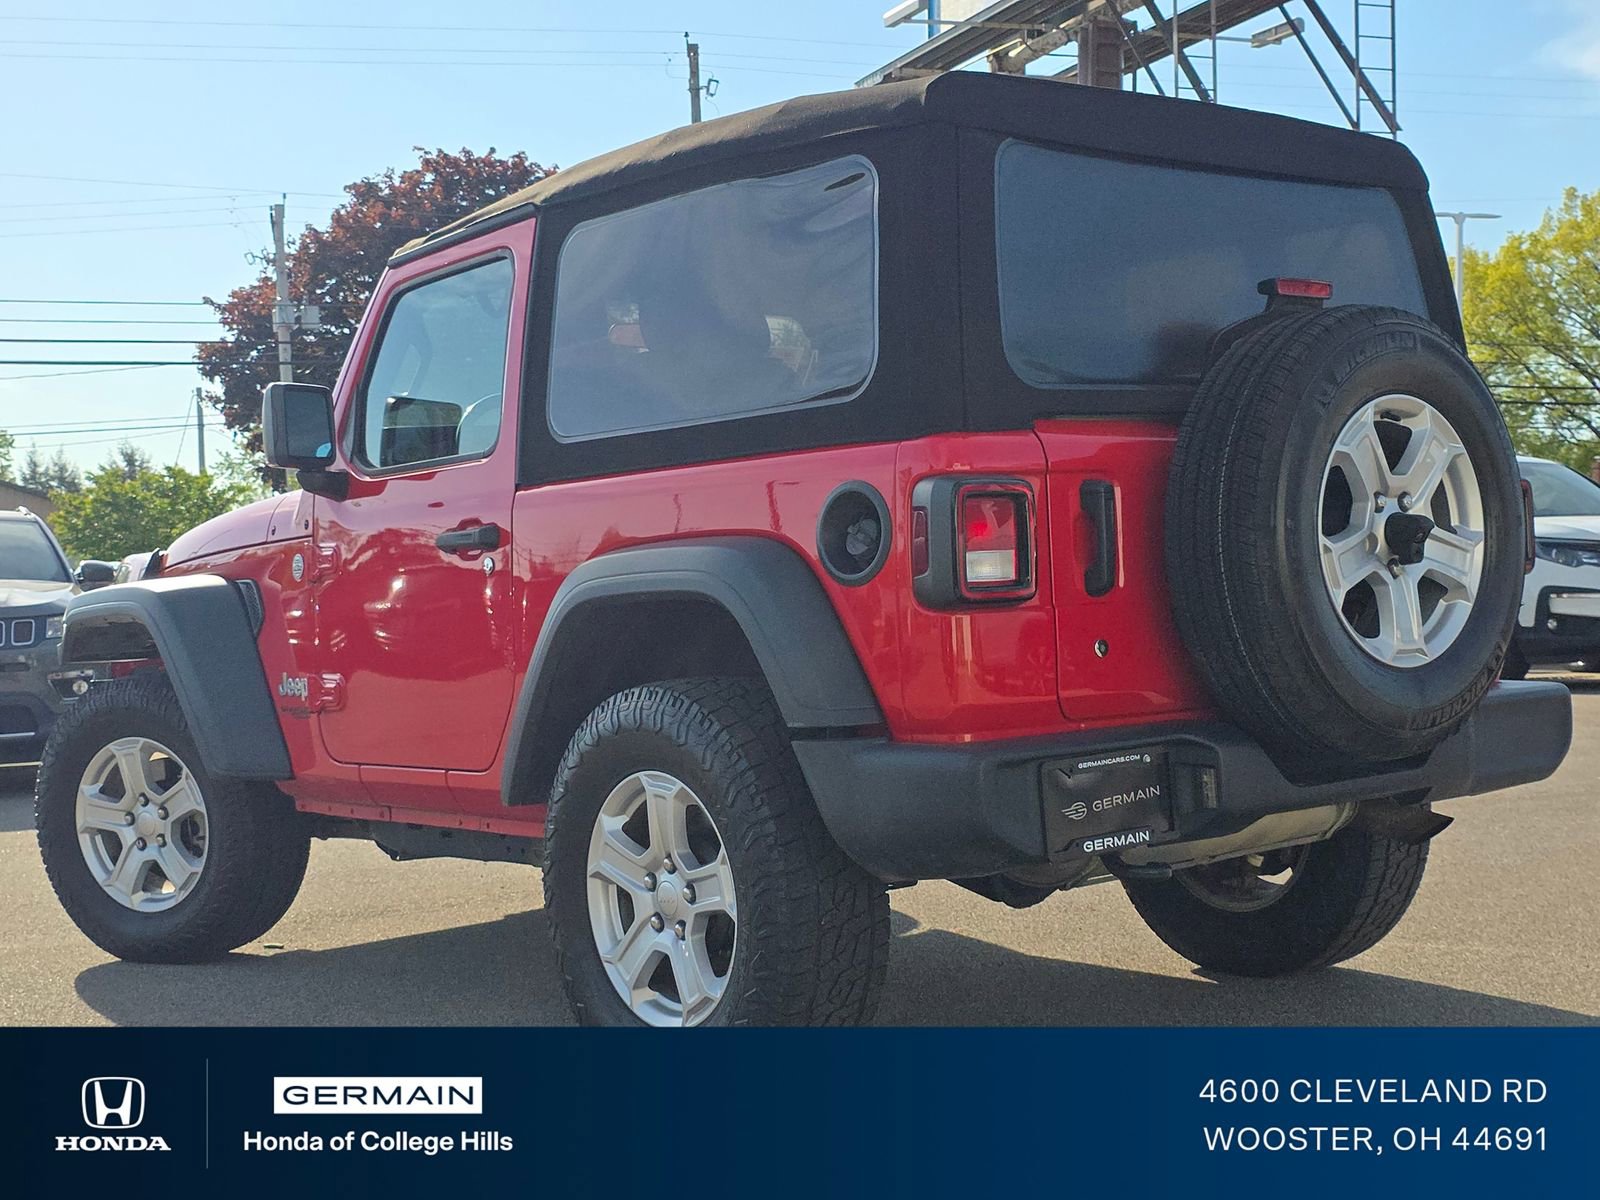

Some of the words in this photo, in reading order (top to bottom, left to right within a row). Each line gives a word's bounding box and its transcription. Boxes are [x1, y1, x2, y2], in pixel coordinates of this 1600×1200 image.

[278, 671, 308, 701] Jeep
[1077, 754, 1141, 769] GERMAINCARS.COM
[1092, 785, 1161, 812] GERMAIN
[1083, 830, 1150, 852] GERMAIN
